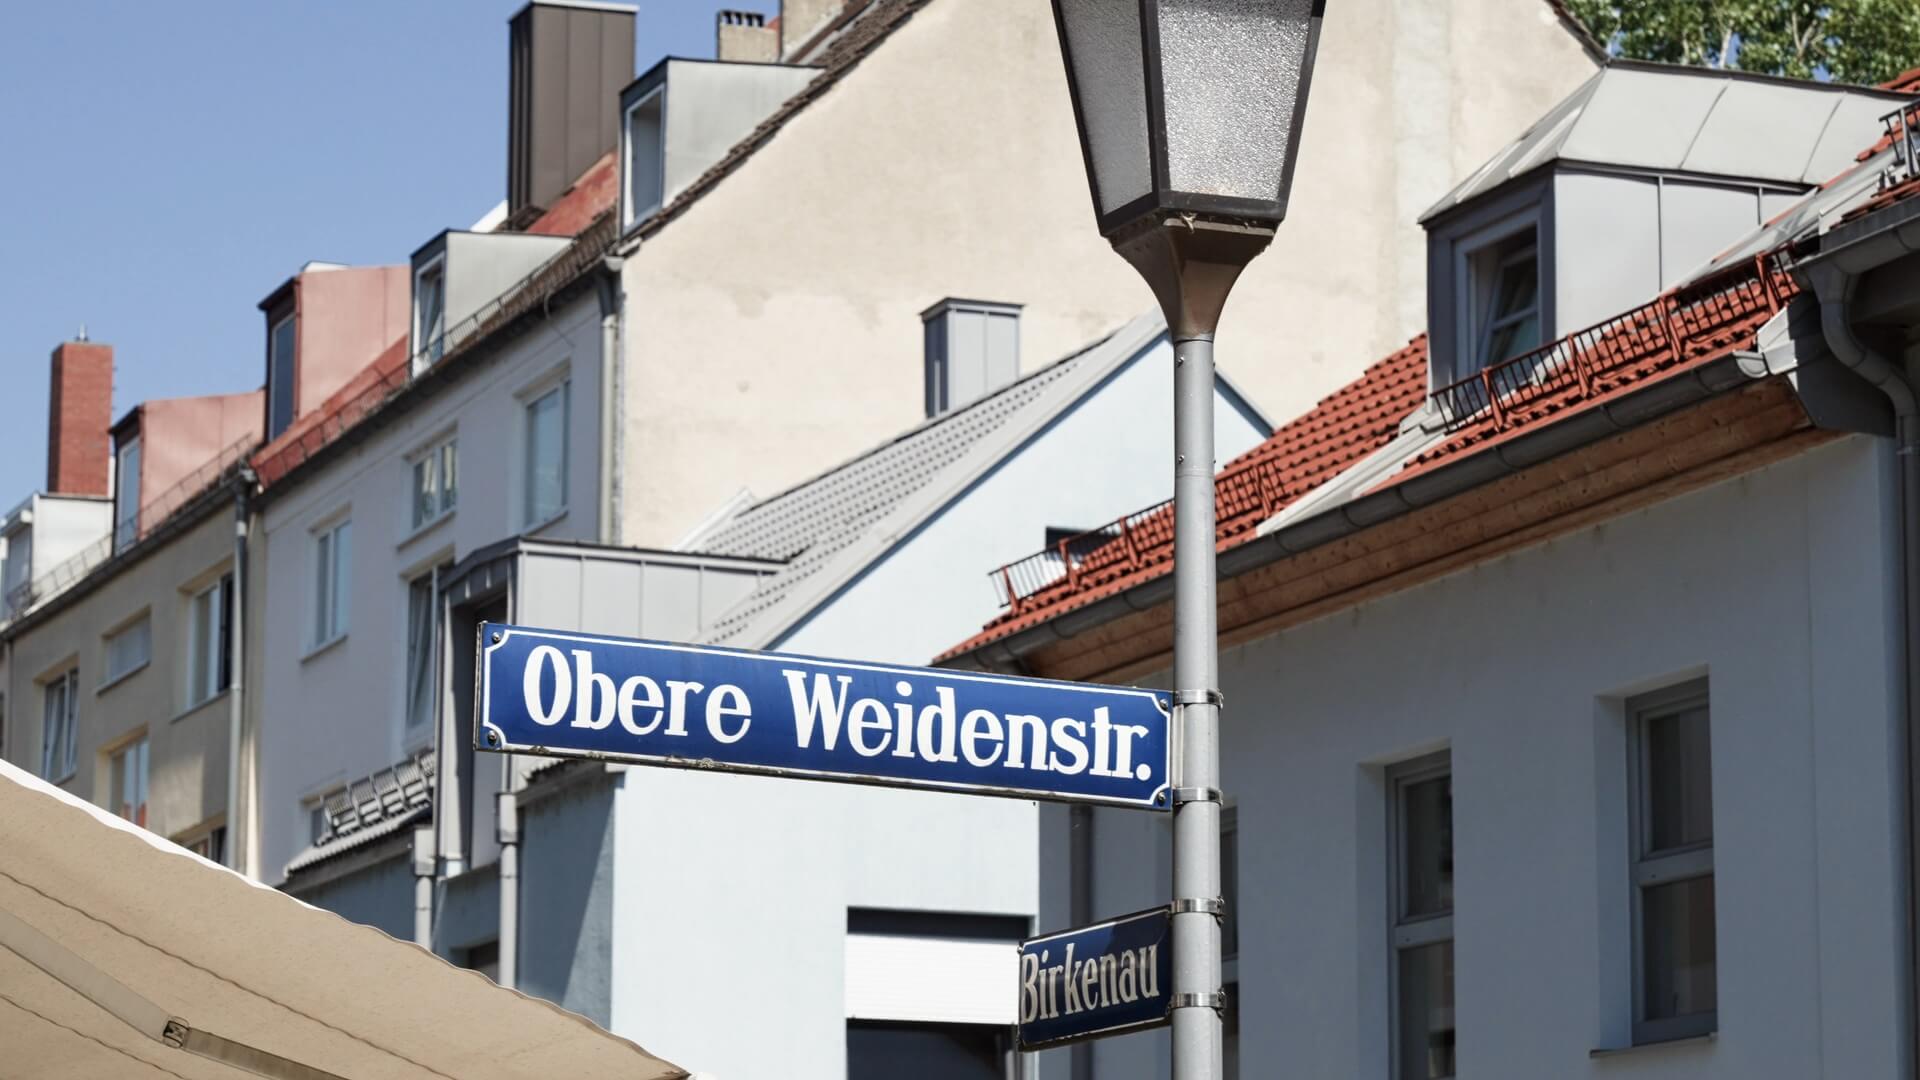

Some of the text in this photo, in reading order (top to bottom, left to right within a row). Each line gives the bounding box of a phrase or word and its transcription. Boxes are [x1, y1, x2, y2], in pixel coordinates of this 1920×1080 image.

[522, 645, 1151, 782] Obere Weidenstr.
[1021, 943, 1160, 1025] Birkenau
